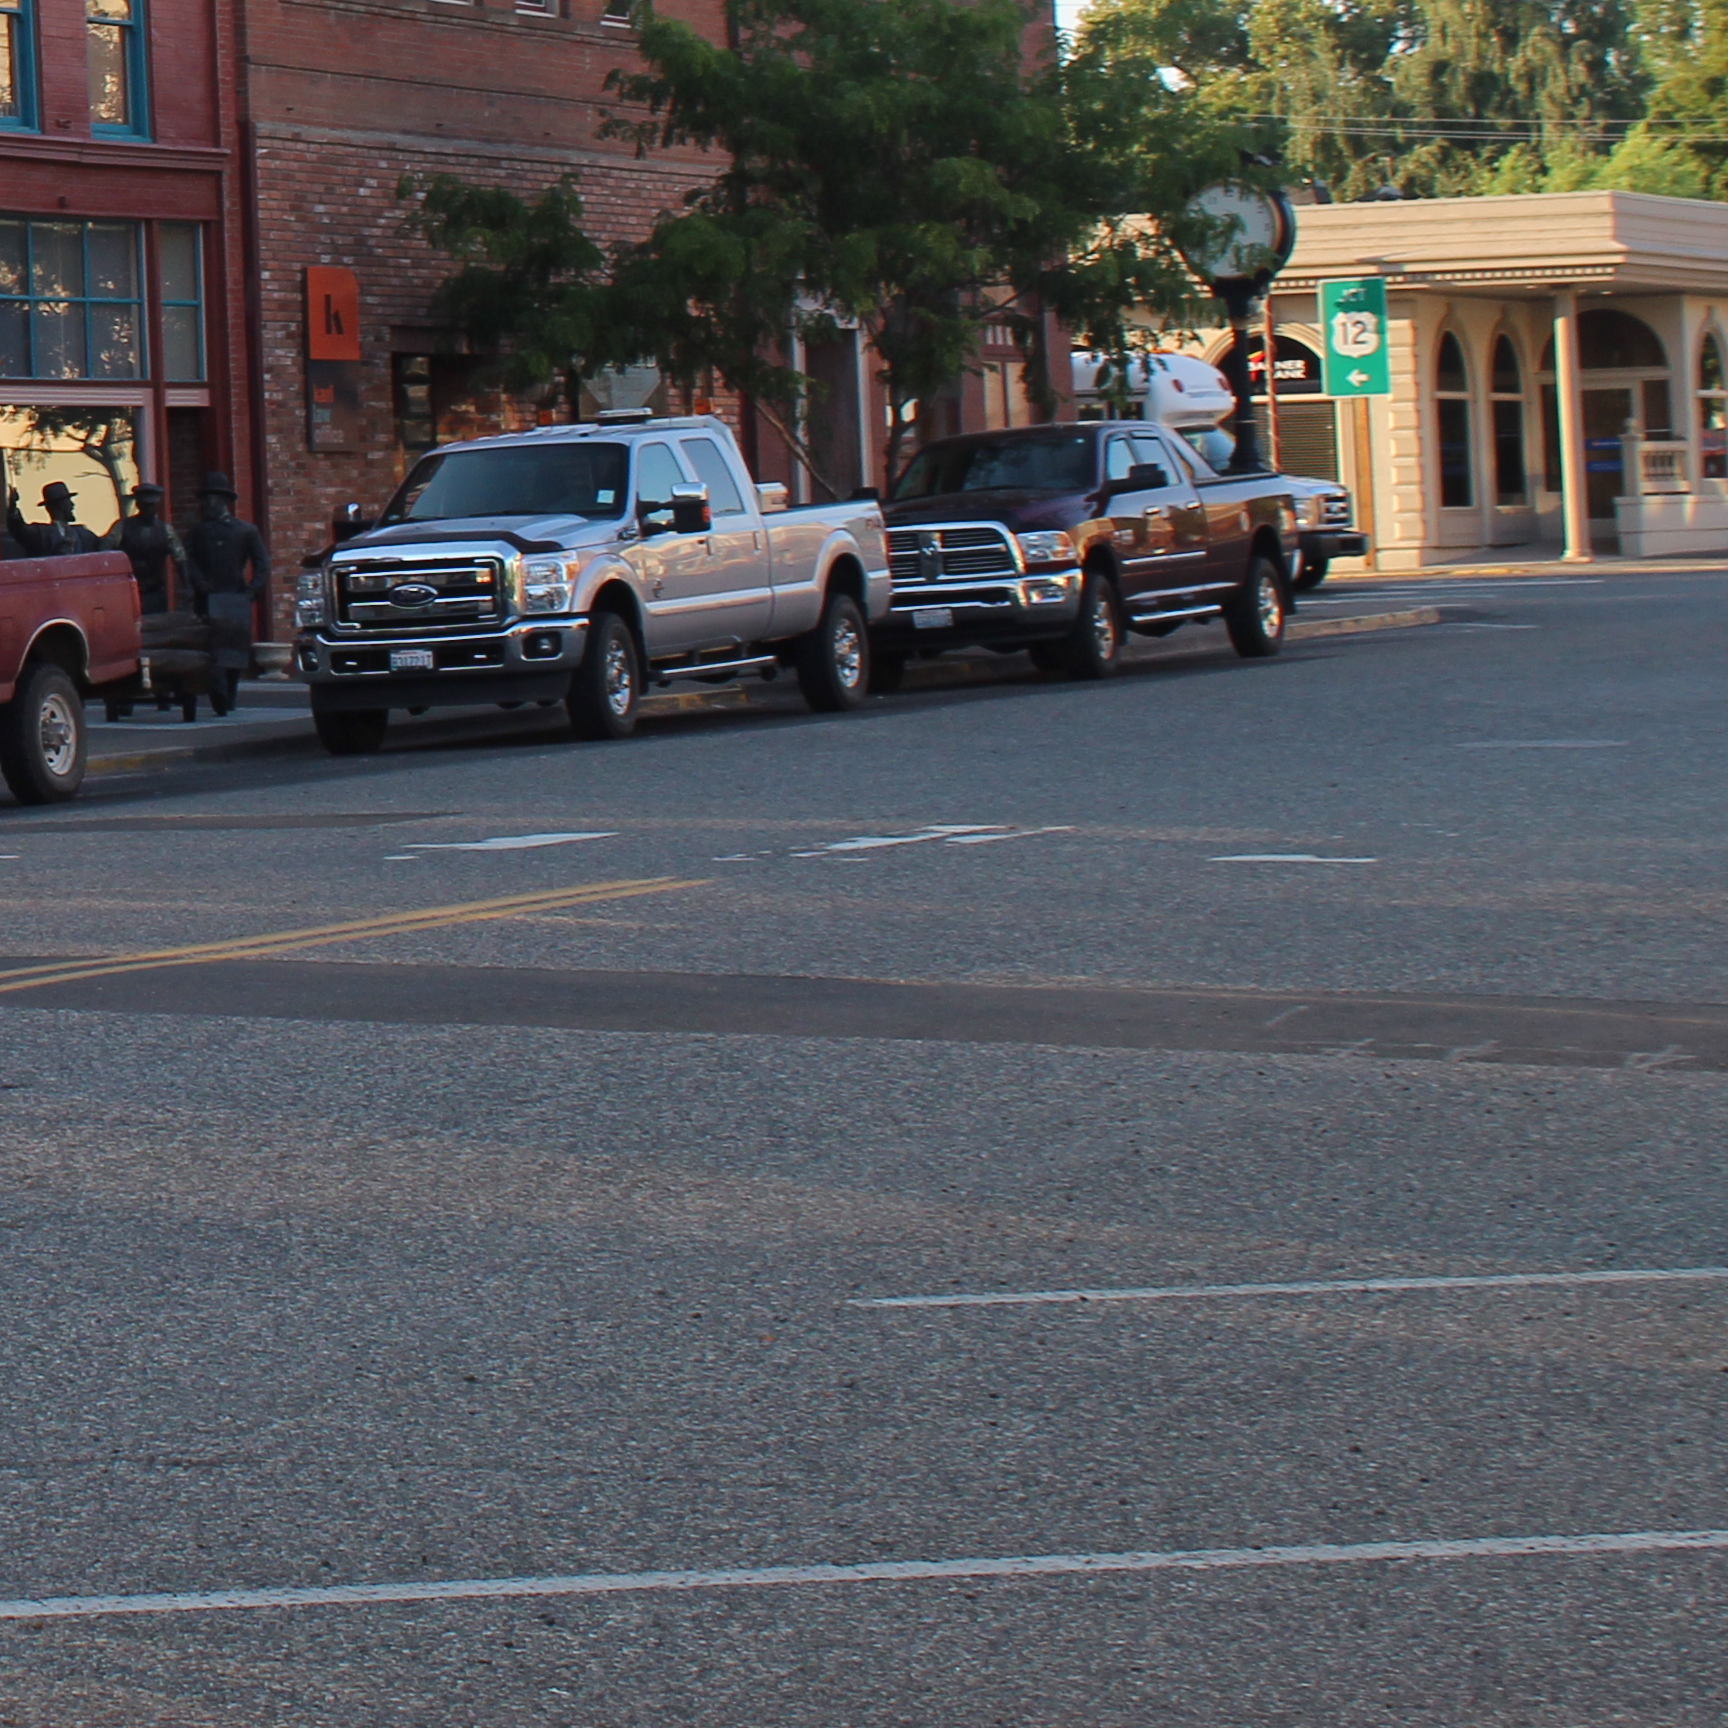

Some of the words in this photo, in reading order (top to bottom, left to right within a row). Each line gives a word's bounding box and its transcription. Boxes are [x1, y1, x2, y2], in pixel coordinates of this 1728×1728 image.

[1335, 287, 1367, 303] JCT
[1339, 320, 1369, 346] 12
[1247, 360, 1306, 371] BANER
